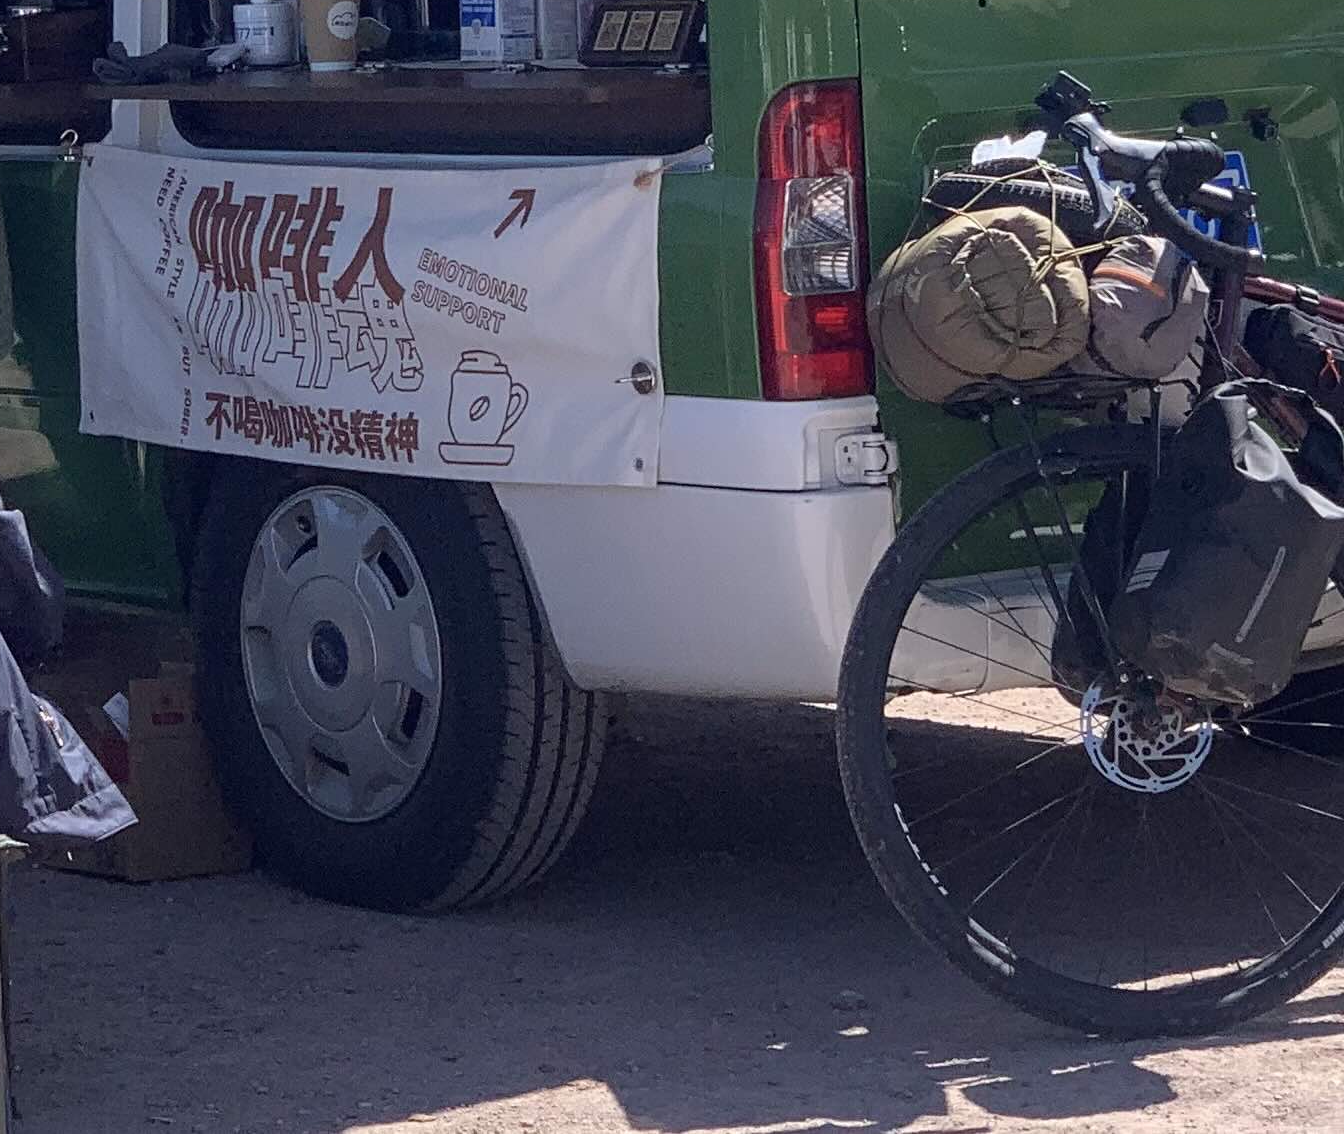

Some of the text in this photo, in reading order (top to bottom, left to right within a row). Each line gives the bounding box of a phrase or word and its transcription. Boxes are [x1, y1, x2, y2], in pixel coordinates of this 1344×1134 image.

[154, 166, 176, 275] NEED COFFEE
[188, 181, 405, 305] 咖啡人
[166, 257, 185, 299] STYLE
[410, 279, 506, 335] SUPPORT
[417, 247, 529, 312] EMOTIONAL
[179, 343, 194, 437] BUT SOBER
[205, 392, 420, 464] 不喝咖啡没精神
